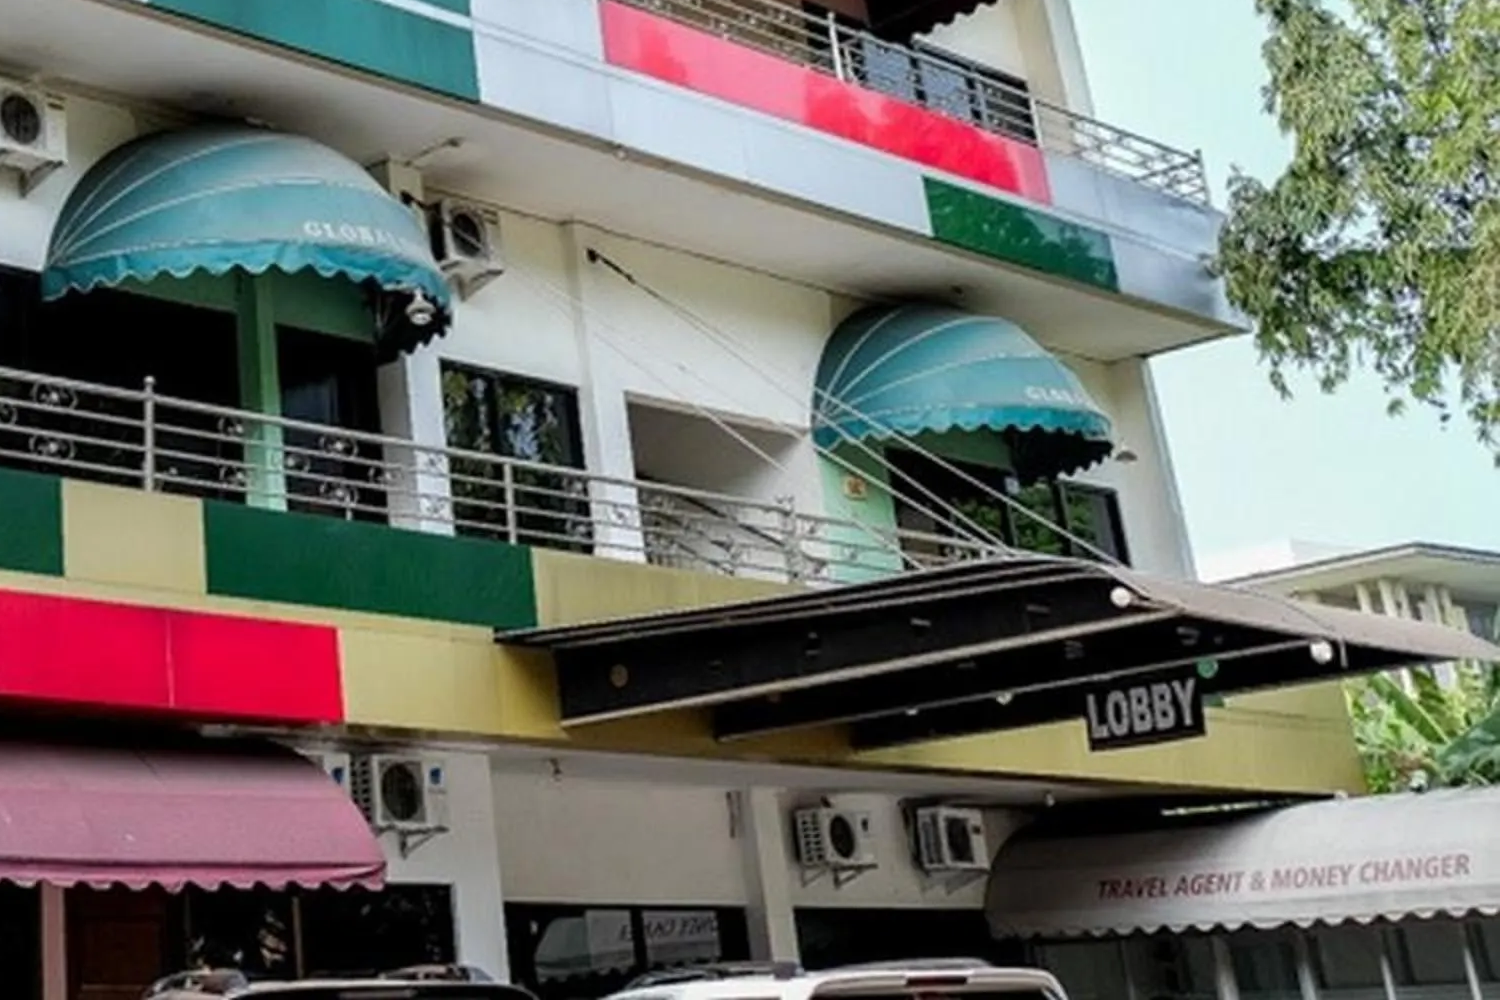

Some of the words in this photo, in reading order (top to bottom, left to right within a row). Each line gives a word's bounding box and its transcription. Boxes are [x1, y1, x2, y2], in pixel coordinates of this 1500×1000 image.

[1086, 677, 1196, 739] LOBBY
[1097, 876, 1170, 900] TRAVEL
[1173, 869, 1243, 897] AGENT
[1249, 869, 1266, 891] &
[1270, 865, 1354, 890] MONEY
[1358, 853, 1471, 883] CHANGER
